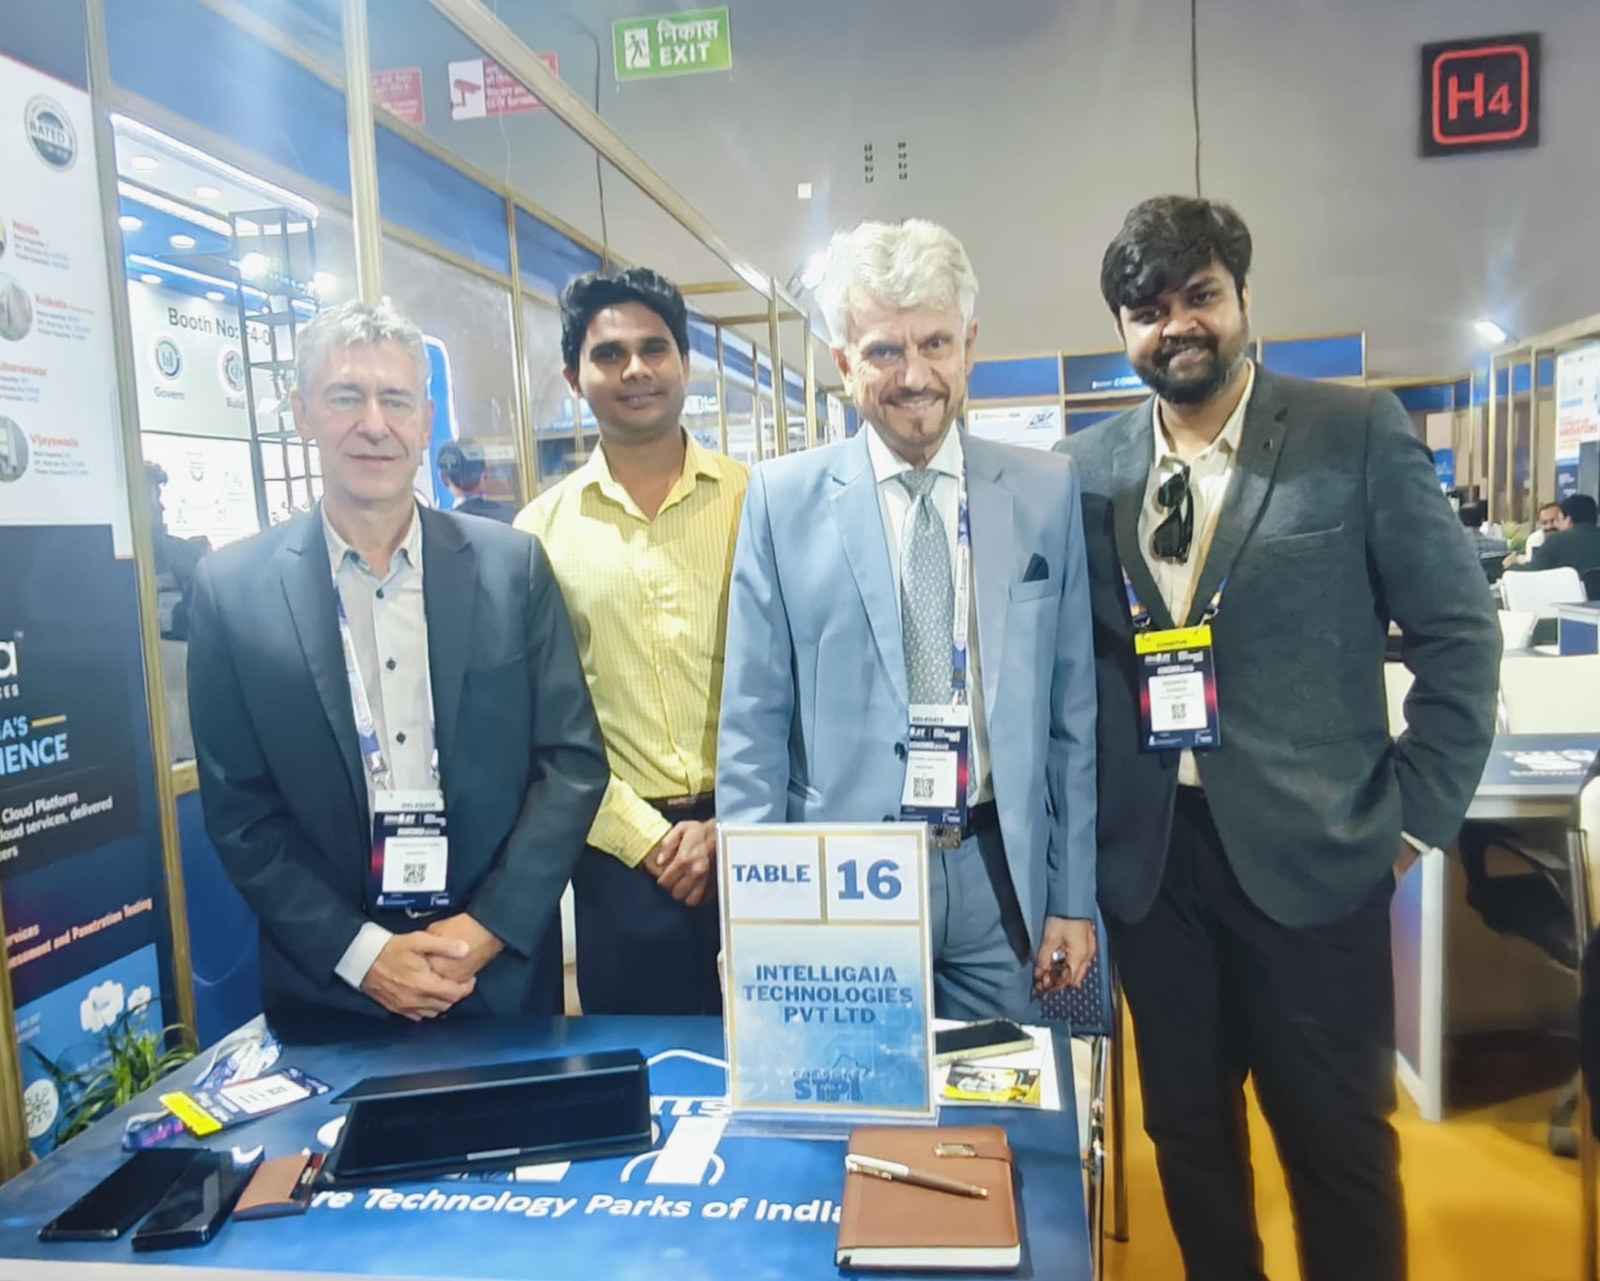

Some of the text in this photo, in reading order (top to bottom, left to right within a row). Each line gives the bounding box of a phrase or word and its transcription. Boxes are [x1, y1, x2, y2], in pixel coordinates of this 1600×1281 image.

[656, 19, 719, 44] निकास
[659, 41, 710, 66] EXIT
[1448, 72, 1512, 120] H4
[167, 306, 212, 334] Booth
[216, 317, 240, 340] No:
[154, 386, 185, 400] Govern
[1, 791, 79, 824] Cloud Platform
[69, 795, 113, 822] delivered
[732, 864, 811, 883] TABLE
[837, 859, 902, 900] 16
[756, 965, 897, 983] INTELLIGAIA
[742, 985, 913, 1004] TECHNOLOGIES
[784, 1006, 876, 1025] PVT LTD
[364, 1188, 578, 1219] Technology
[584, 1194, 692, 1219] Parks
[701, 1197, 749, 1220] of
